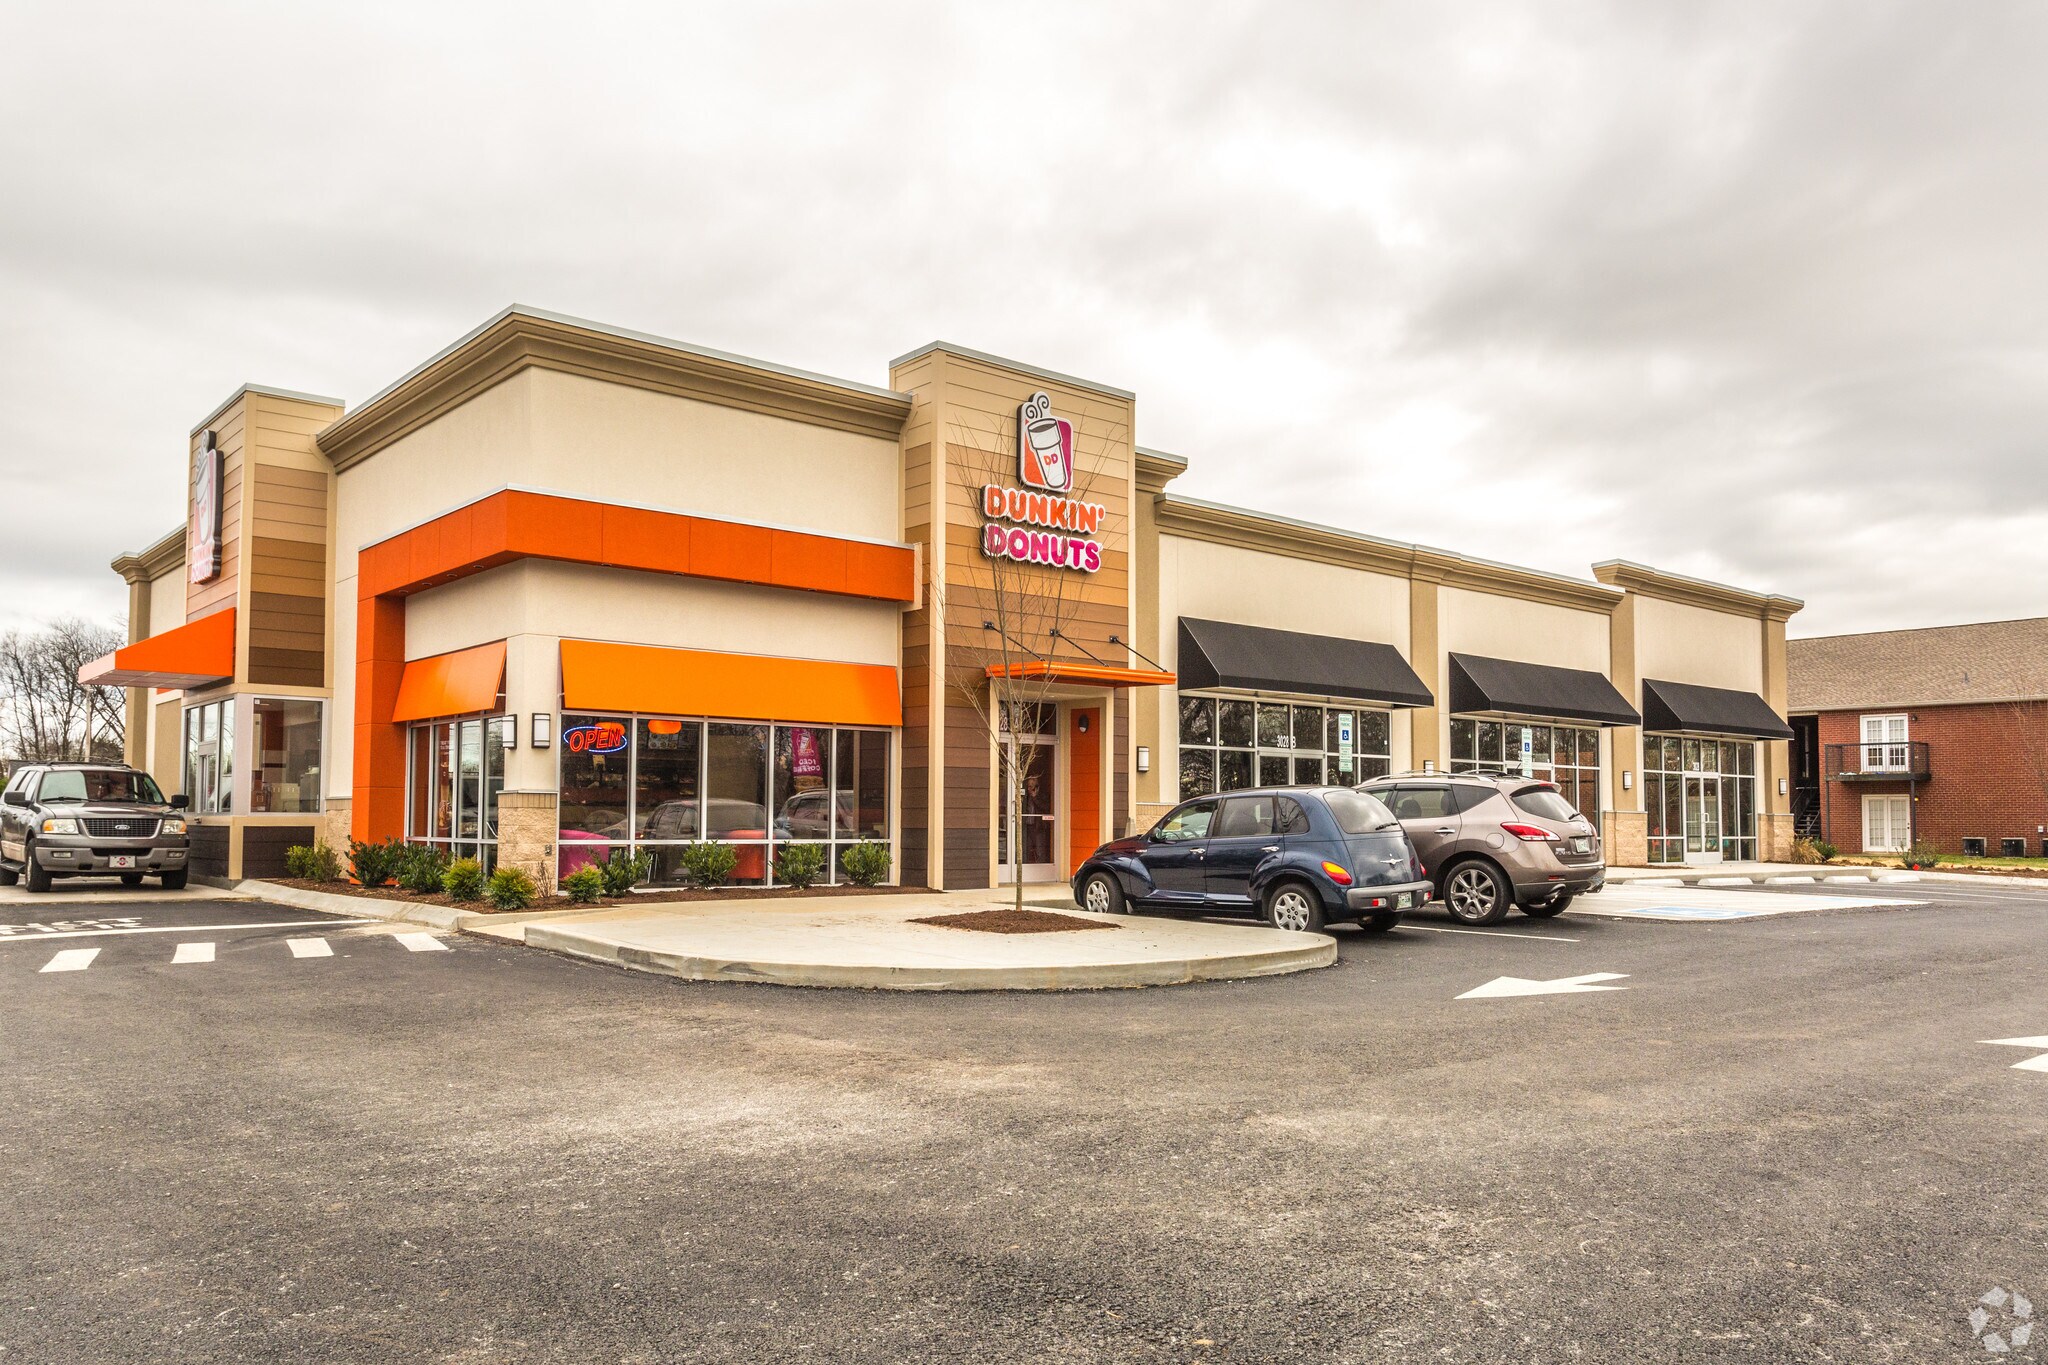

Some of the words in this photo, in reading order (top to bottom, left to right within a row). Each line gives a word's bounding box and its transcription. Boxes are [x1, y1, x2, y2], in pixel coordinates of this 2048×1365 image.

[1043, 453, 1059, 466] DD
[985, 486, 1105, 533] DUNKIN'
[986, 525, 1100, 571] DONUTS
[569, 728, 621, 752] OPEN
